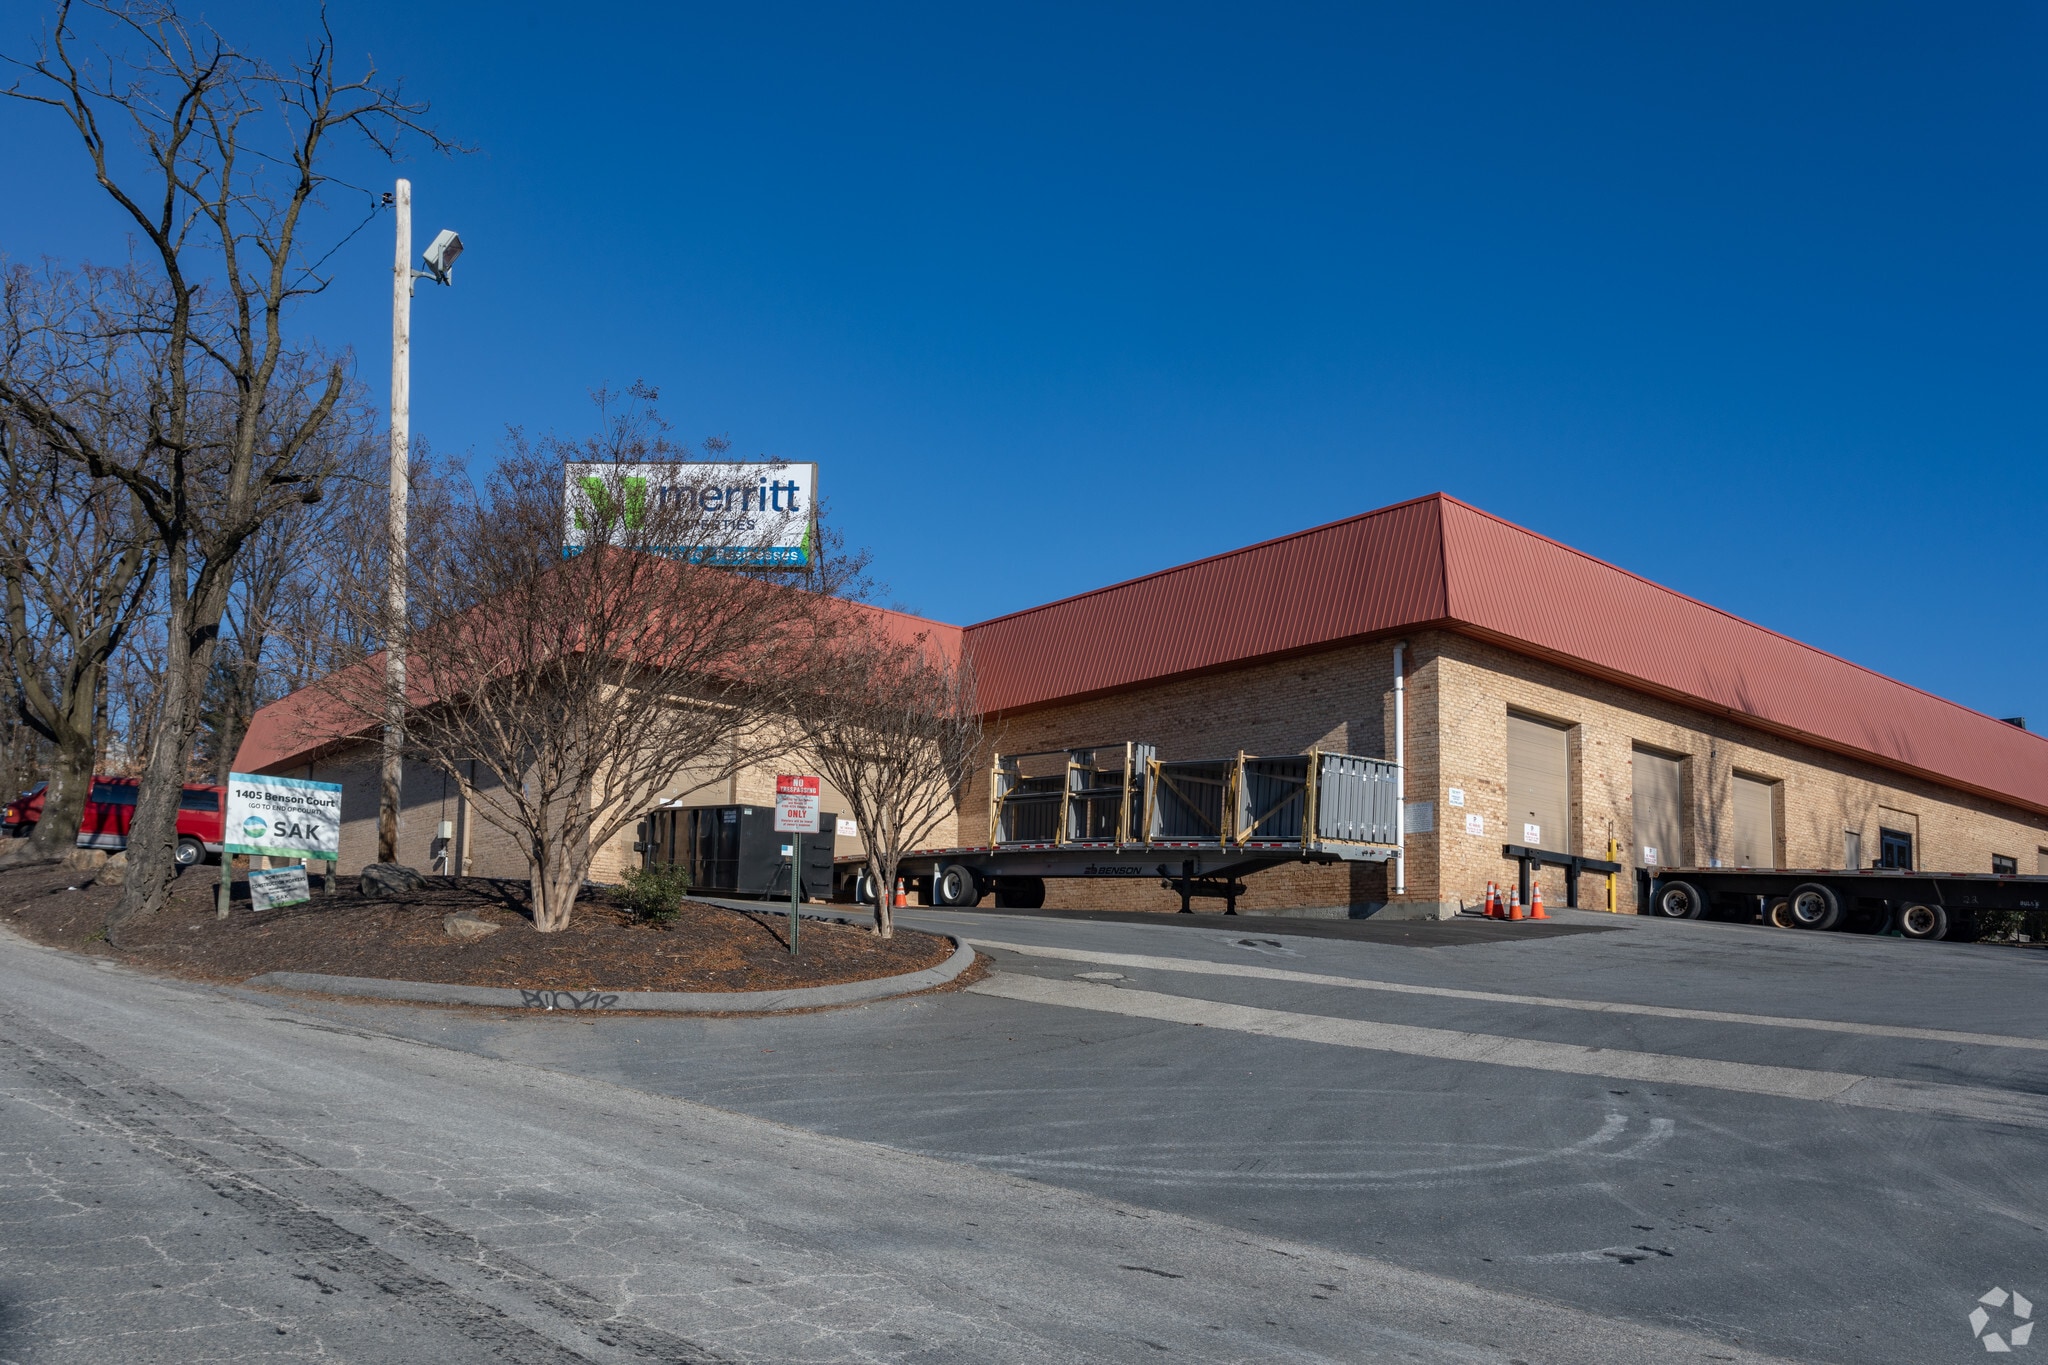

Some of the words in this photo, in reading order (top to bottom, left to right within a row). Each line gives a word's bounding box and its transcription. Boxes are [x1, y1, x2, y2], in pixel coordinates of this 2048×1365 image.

[660, 476, 800, 512] merritt
[793, 778, 804, 787] NO
[780, 786, 817, 794] TRESPASSING
[236, 789, 263, 800] 1405
[264, 792, 304, 804] Benson
[306, 797, 336, 808] Court
[262, 803, 272, 811] TO
[787, 809, 807, 818] ONLY
[274, 821, 320, 841] SAK
[1098, 866, 1143, 874] BENSON
